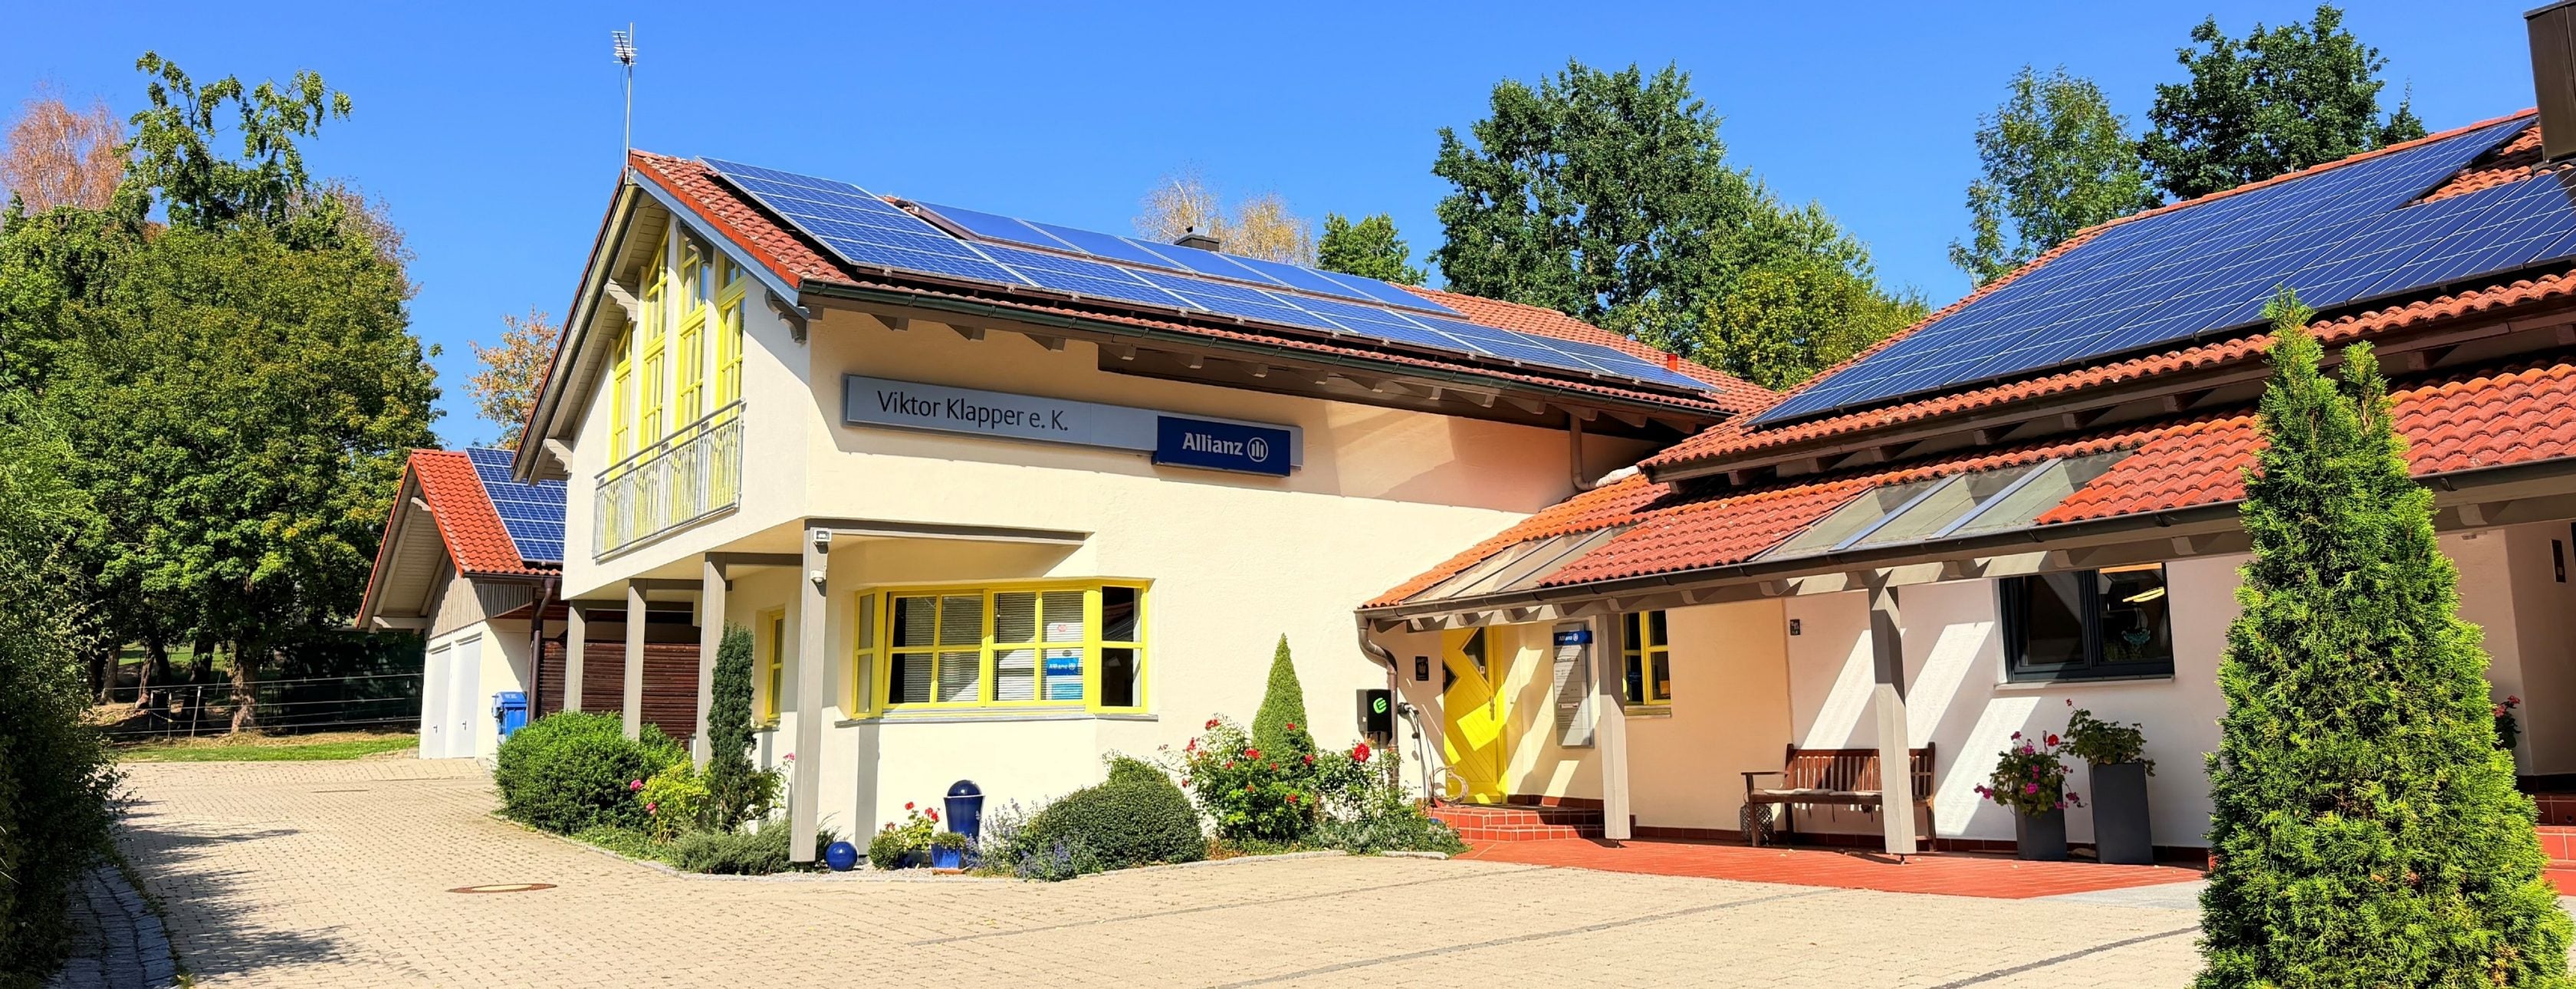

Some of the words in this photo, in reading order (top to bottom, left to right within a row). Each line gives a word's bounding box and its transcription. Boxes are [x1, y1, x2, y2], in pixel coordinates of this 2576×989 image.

[878, 390, 941, 416] Viktor
[947, 398, 1024, 429] Klapper
[1029, 413, 1046, 429] e.
[1051, 409, 1068, 431] K.
[1182, 432, 1243, 455] Allianz
